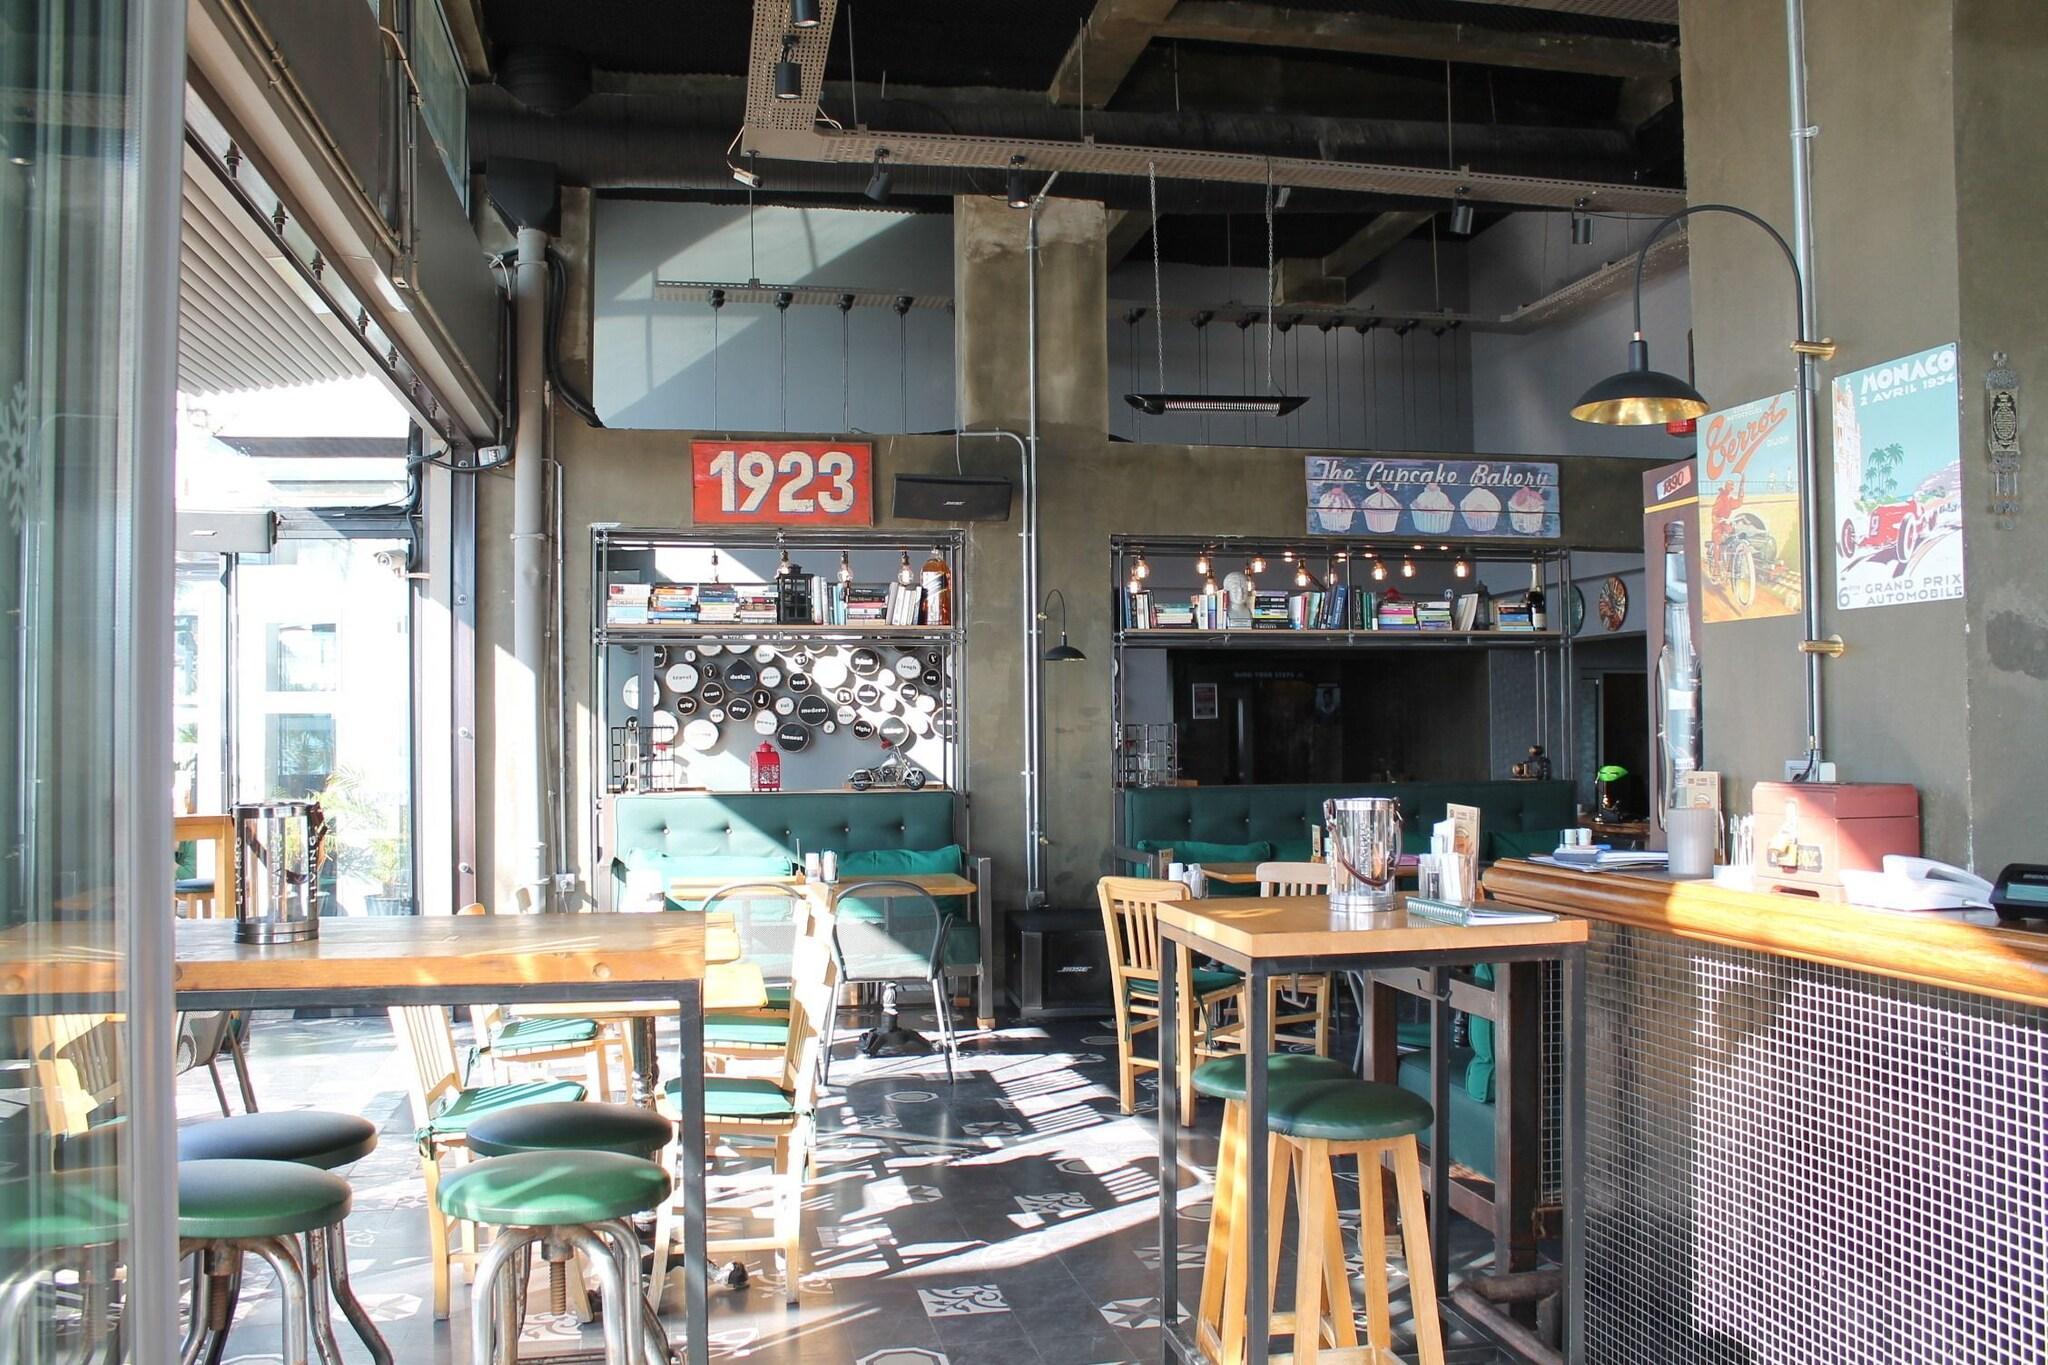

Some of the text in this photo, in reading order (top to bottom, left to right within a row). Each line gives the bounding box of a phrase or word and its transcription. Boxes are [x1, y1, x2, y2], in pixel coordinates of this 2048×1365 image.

[1861, 350, 1956, 396] MONACO
[1872, 384, 1918, 403] AVRIL
[1923, 372, 1956, 390] 1934
[710, 450, 855, 513] 1923
[1315, 460, 1549, 494] The Cupcake Bakery
[1864, 579, 1914, 594] GRAND
[1923, 573, 1962, 588] PRIX
[1866, 585, 1963, 606] AUTOMOBILE
[730, 672, 751, 681] design
[801, 706, 826, 714] modern
[309, 836, 318, 903] LIVING
